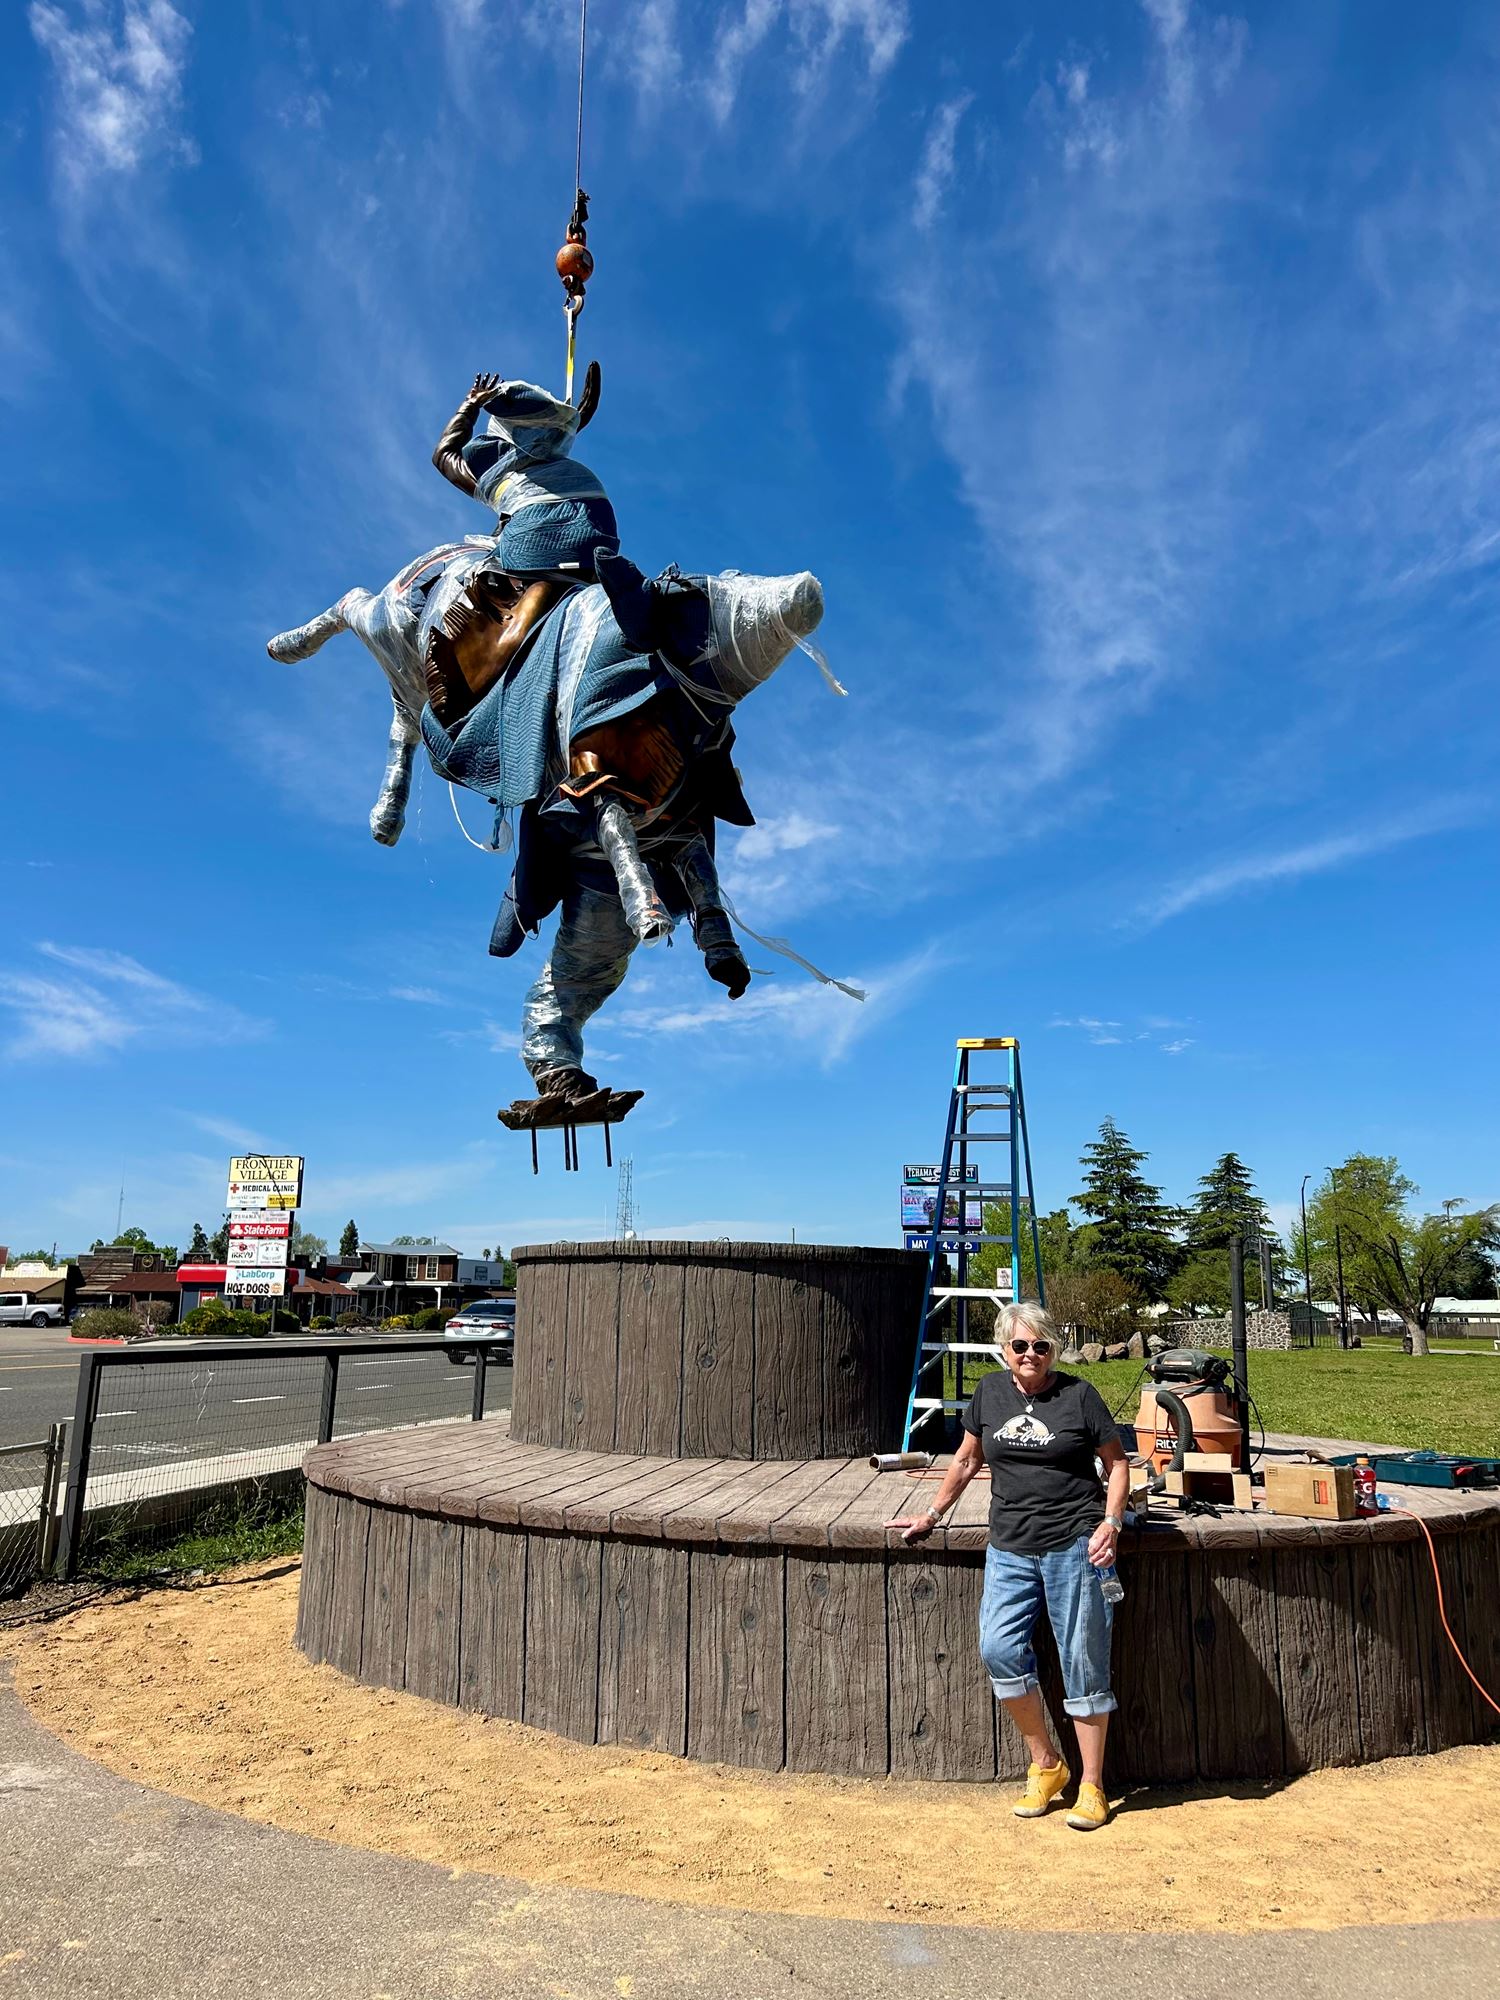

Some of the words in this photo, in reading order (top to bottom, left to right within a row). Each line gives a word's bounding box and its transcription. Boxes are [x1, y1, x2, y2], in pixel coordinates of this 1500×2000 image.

[235, 1159, 294, 1170] FRONTIER
[239, 1170, 288, 1180] VILLAGE
[907, 1167, 933, 1177] TEHAMA
[242, 1184, 271, 1192] MEDICAL
[272, 1184, 295, 1192] CLINIC
[911, 1240, 929, 1249] MAY
[241, 1270, 275, 1279] LabCorp
[1019, 1429, 1056, 1446] Bluff
[1363, 1482, 1373, 1494] G
